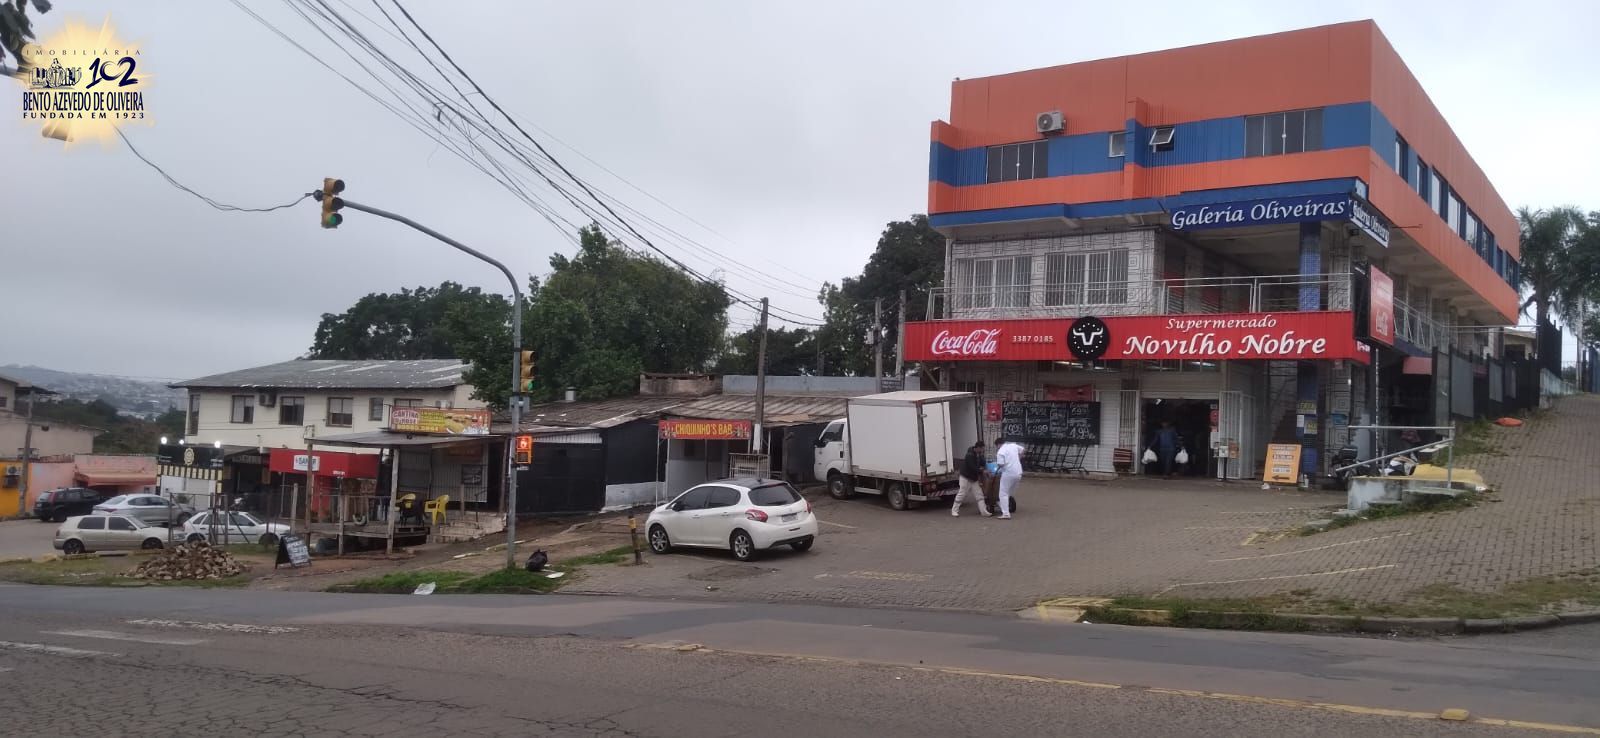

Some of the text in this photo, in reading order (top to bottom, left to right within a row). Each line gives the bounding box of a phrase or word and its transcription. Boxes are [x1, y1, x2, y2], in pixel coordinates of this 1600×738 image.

[1172, 200, 1345, 230] Galeria Oliveiras
[1166, 314, 1277, 333] Supermercado
[931, 328, 1002, 356] Coca-Cola
[1012, 335, 1032, 343] 3387
[1122, 332, 1232, 356] Novilho
[1238, 330, 1327, 356] Nobre
